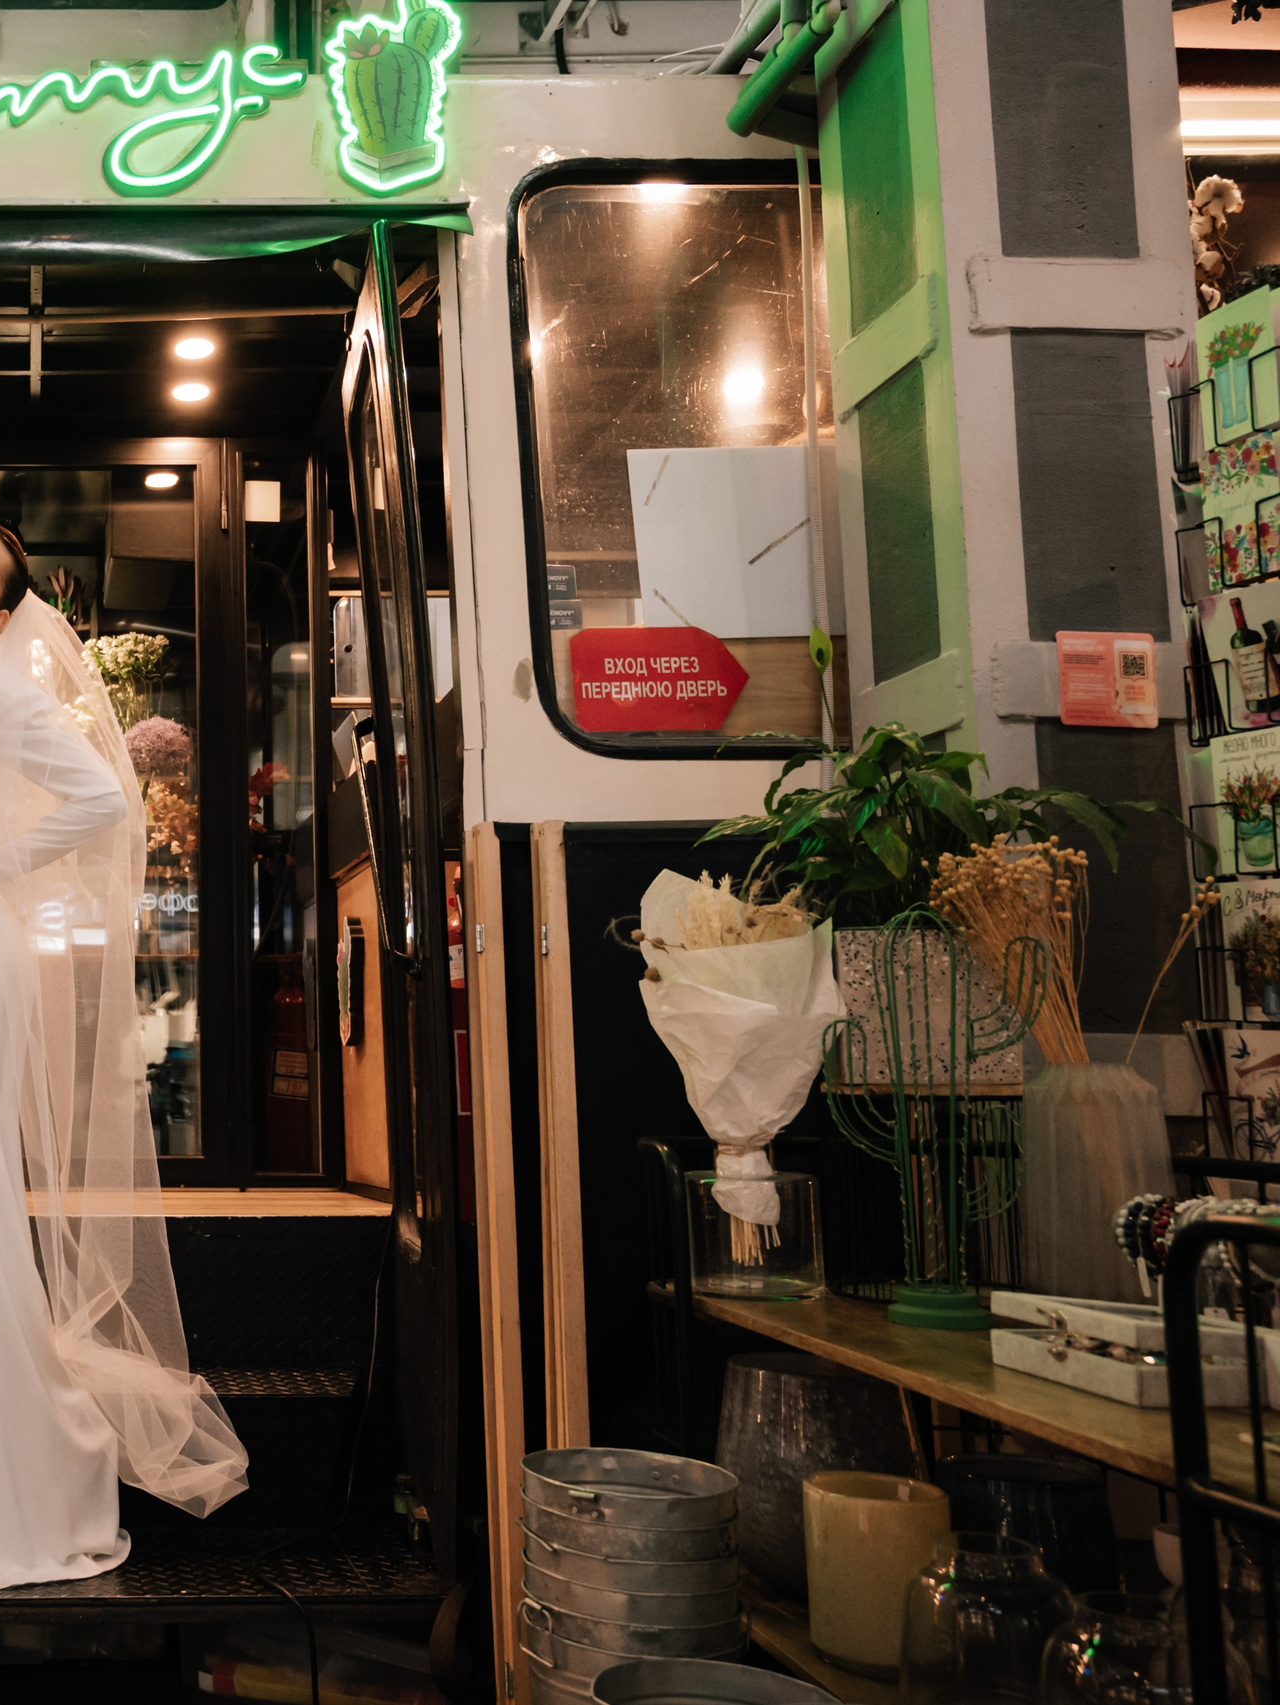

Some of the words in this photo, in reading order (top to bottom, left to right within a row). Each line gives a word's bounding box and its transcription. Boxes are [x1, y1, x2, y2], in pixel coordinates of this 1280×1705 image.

[604, 657, 647, 677] ВХОД
[650, 656, 700, 674] ЧЕРЕЗ
[581, 680, 672, 702] ПЕРЕДНЮЮ
[676, 680, 728, 700] ДВЕРЬ
